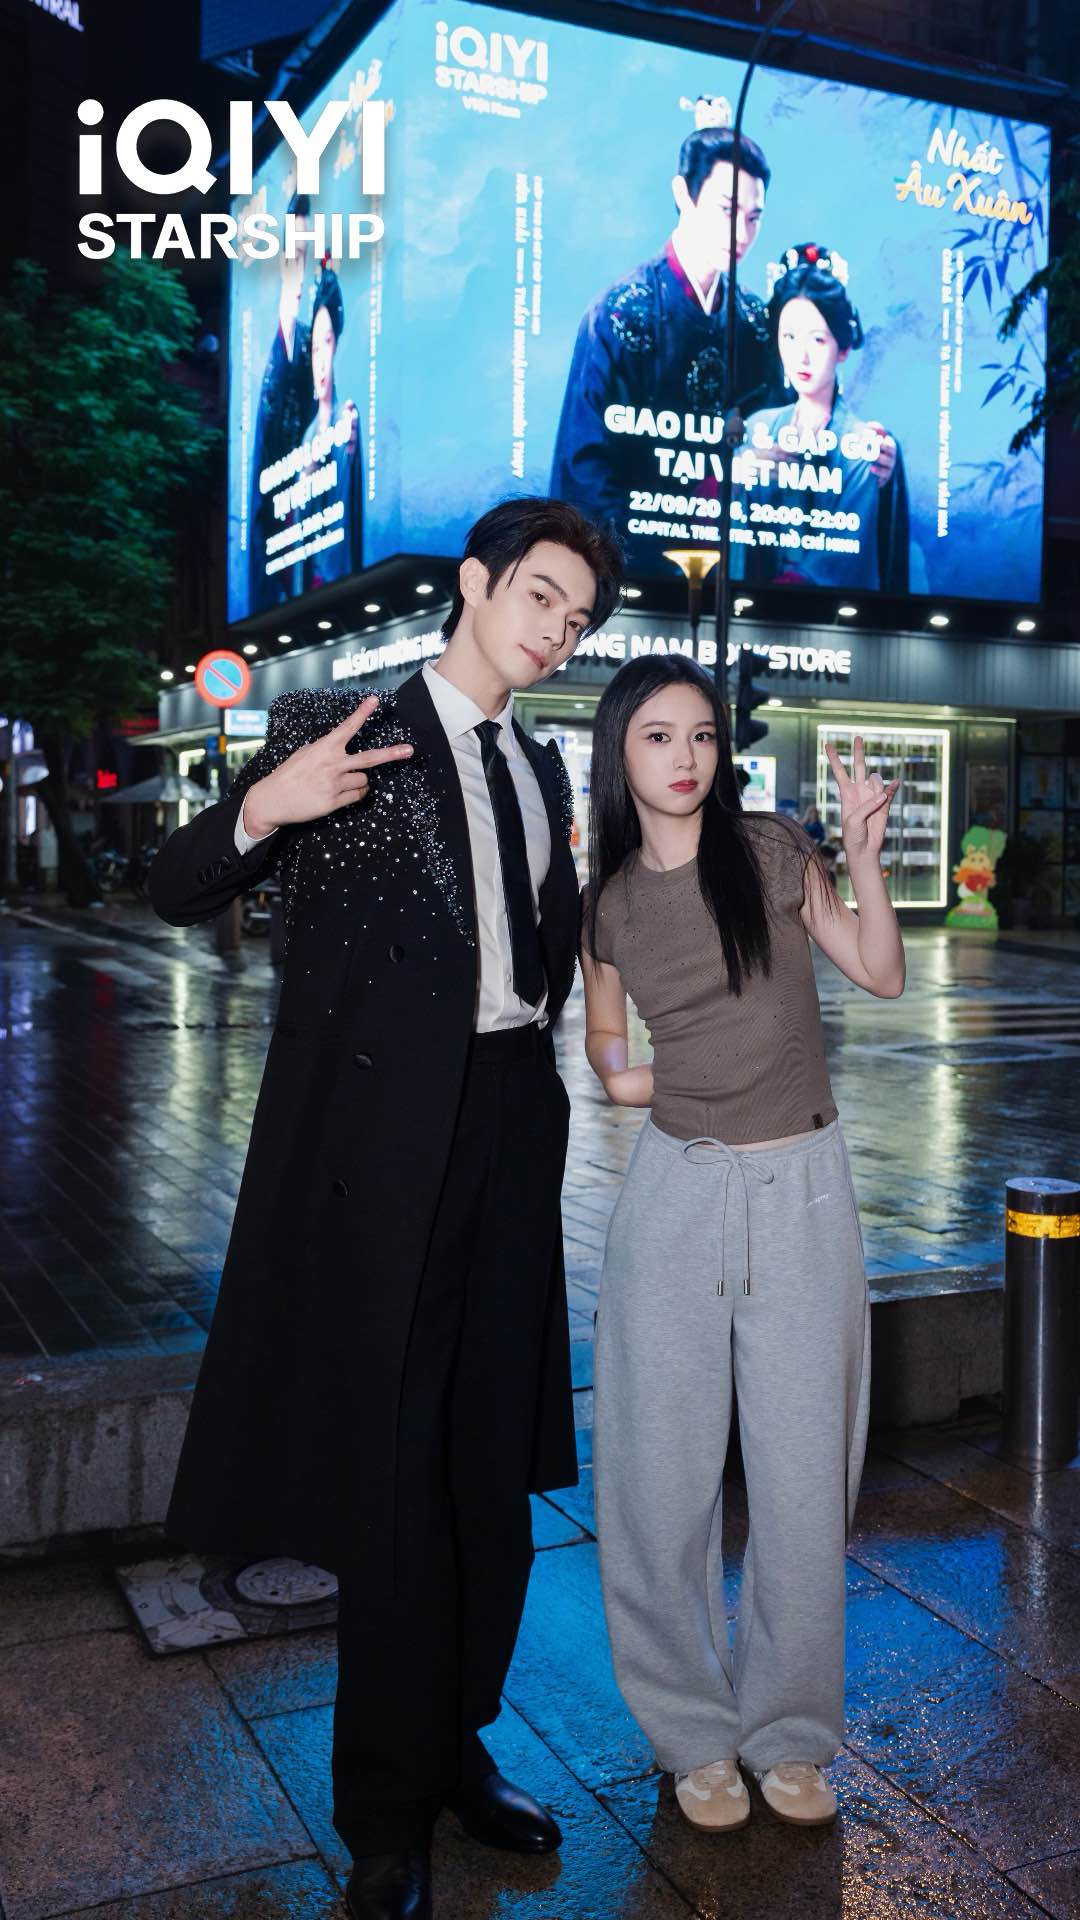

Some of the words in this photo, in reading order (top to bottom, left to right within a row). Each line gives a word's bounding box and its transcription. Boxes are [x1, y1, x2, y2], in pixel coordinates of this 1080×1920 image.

[435, 20, 549, 83] iQIYI
[435, 64, 549, 105] STARSHIP
[927, 127, 1005, 175] Nhất
[895, 160, 946, 209] Âu
[946, 172, 1034, 225] Xuân
[604, 403, 682, 440] GIAO
[653, 447, 705, 485] TẠI
[778, 461, 843, 495] NAM
[627, 518, 690, 540] CAPITAL
[749, 503, 861, 531] 20:00-22:00
[630, 634, 693, 659] NAM
